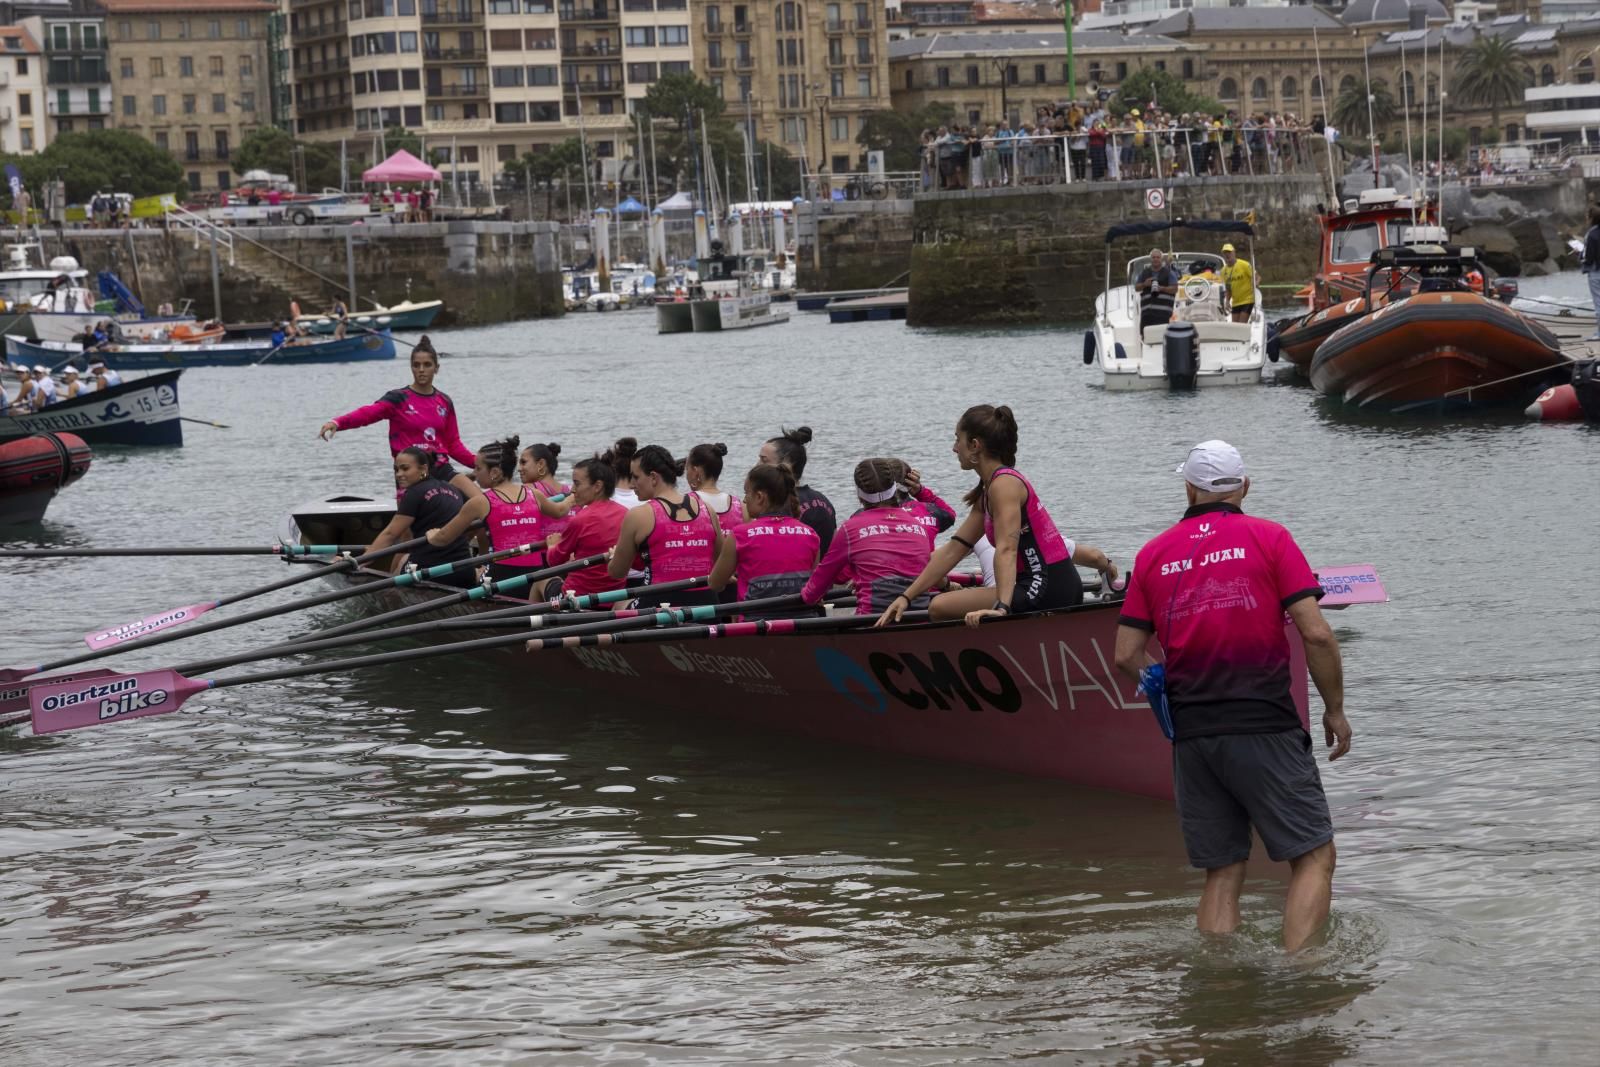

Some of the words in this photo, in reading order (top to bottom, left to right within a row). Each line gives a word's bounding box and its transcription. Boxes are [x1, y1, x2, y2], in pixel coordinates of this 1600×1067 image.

[137, 396, 153, 413] 15
[20, 412, 95, 431] PEREIRA
[747, 526, 774, 538] SAN
[778, 526, 813, 536] JUAN
[859, 525, 890, 538] SAN
[895, 524, 927, 537] JUAN
[664, 540, 684, 549] SAN
[1024, 547, 1043, 573] SAN
[1160, 559, 1193, 576] SAN
[1199, 547, 1246, 567] JUAN
[42, 677, 138, 712] Oiartzun
[98, 688, 169, 721] bike
